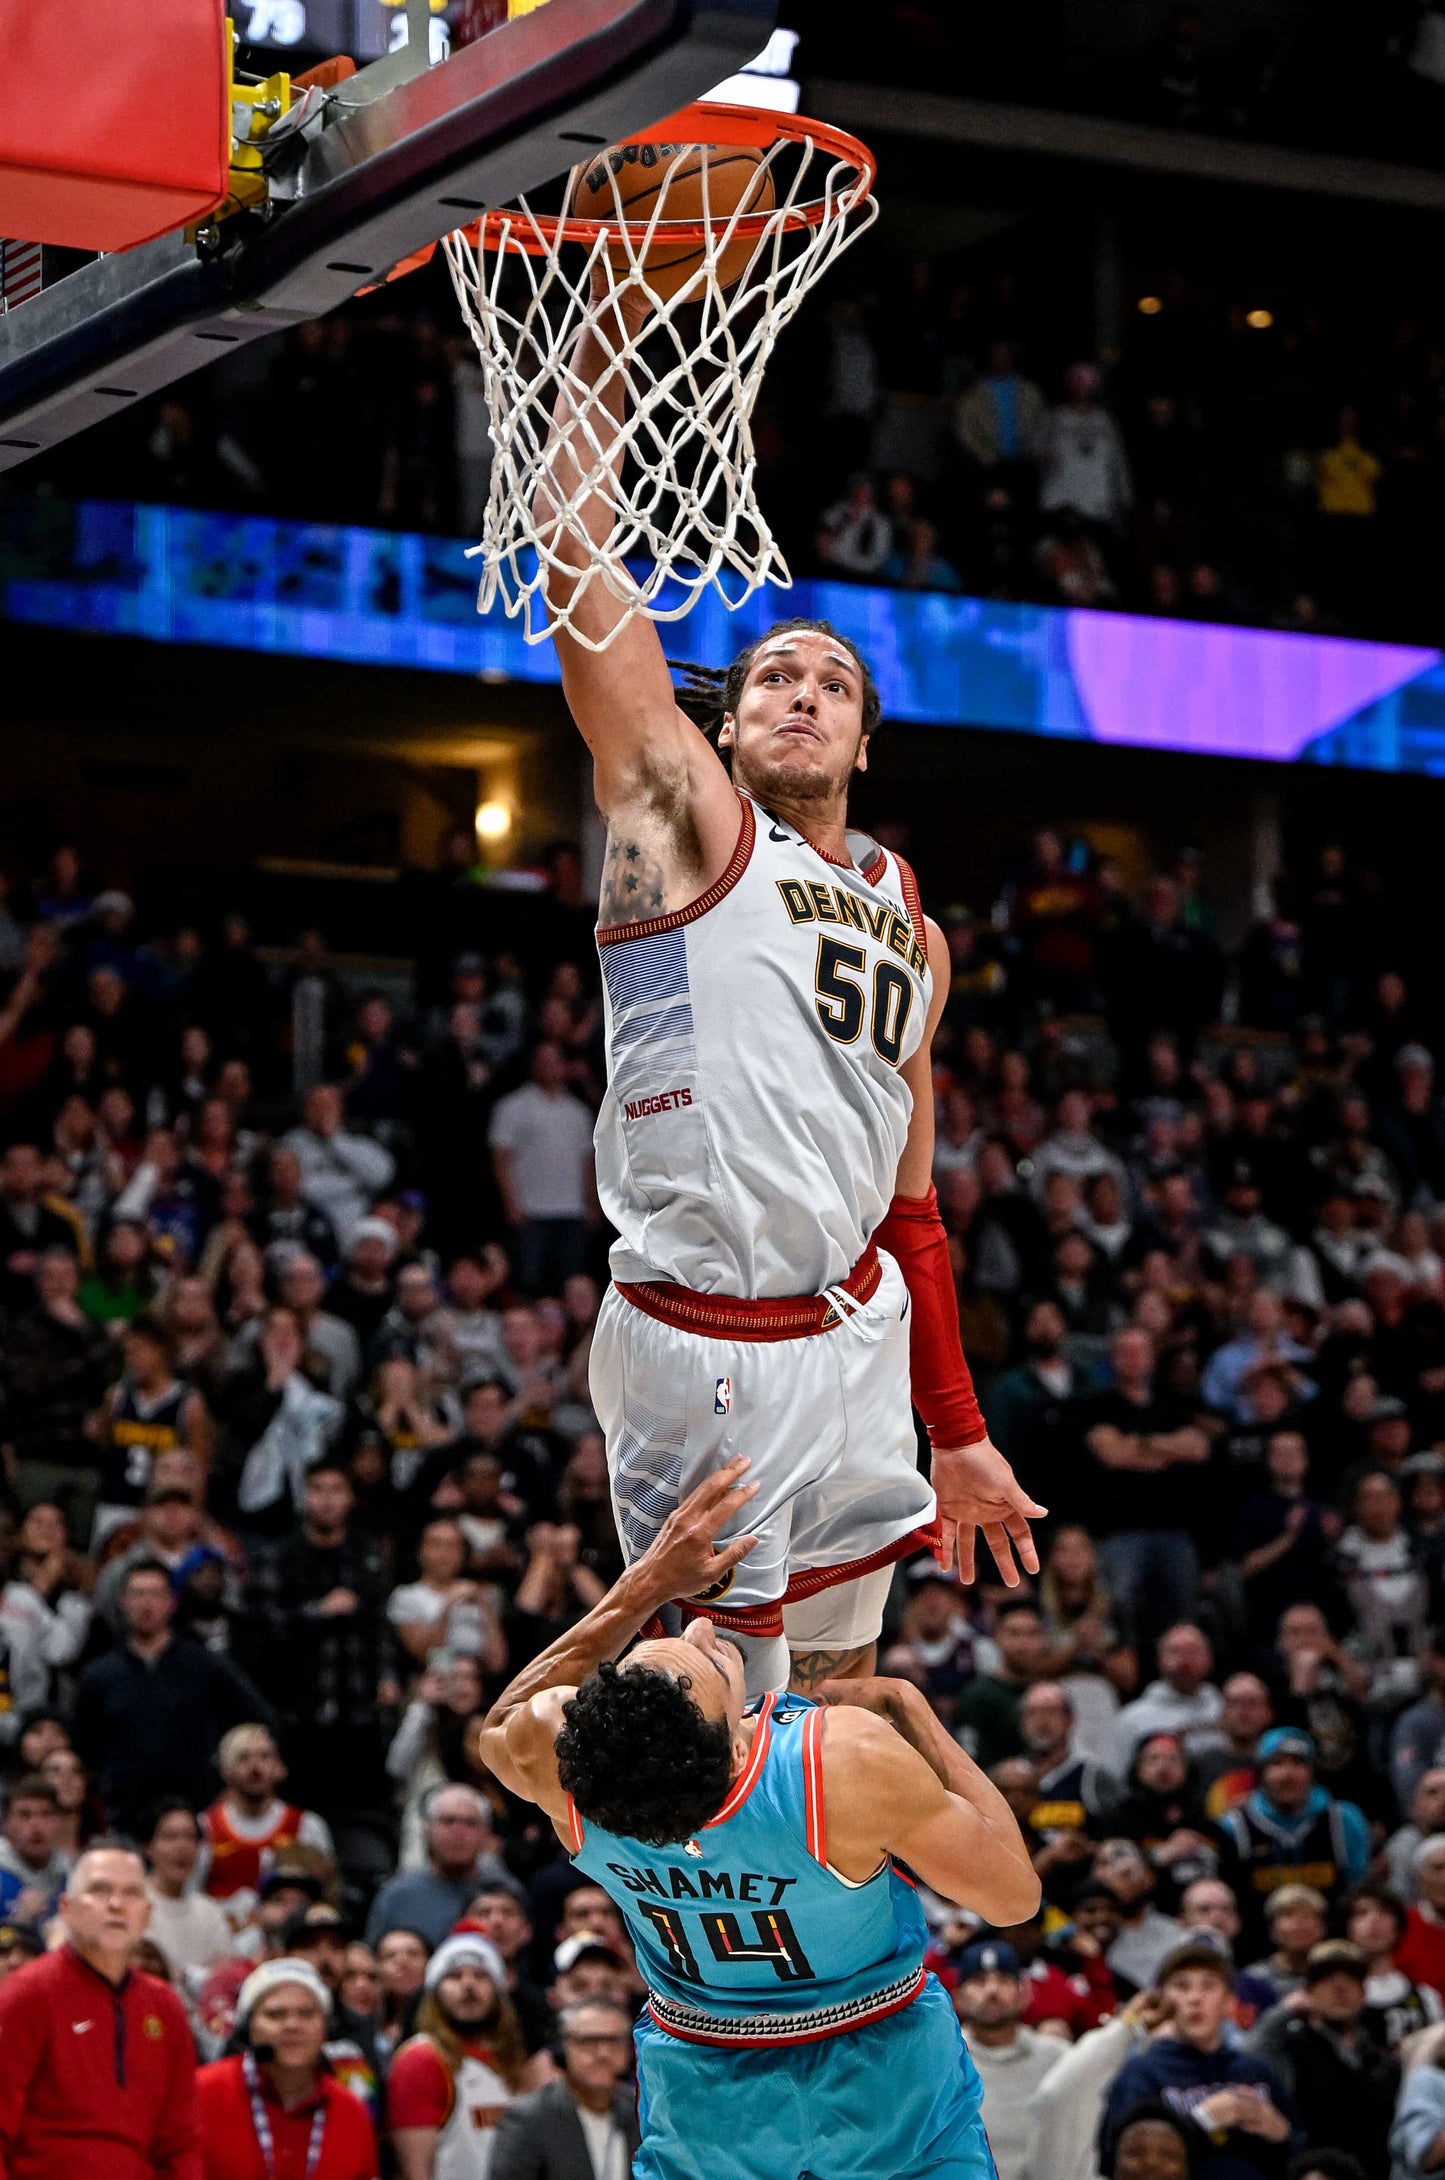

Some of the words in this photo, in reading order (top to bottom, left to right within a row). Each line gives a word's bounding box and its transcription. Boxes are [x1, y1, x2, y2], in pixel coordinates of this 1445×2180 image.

[775, 879, 928, 983] DENVER
[815, 933, 914, 1068] 50
[624, 1087, 693, 1122] NUGGETS
[605, 1862, 798, 1906] SHAMET
[636, 1898, 816, 1985] 14
